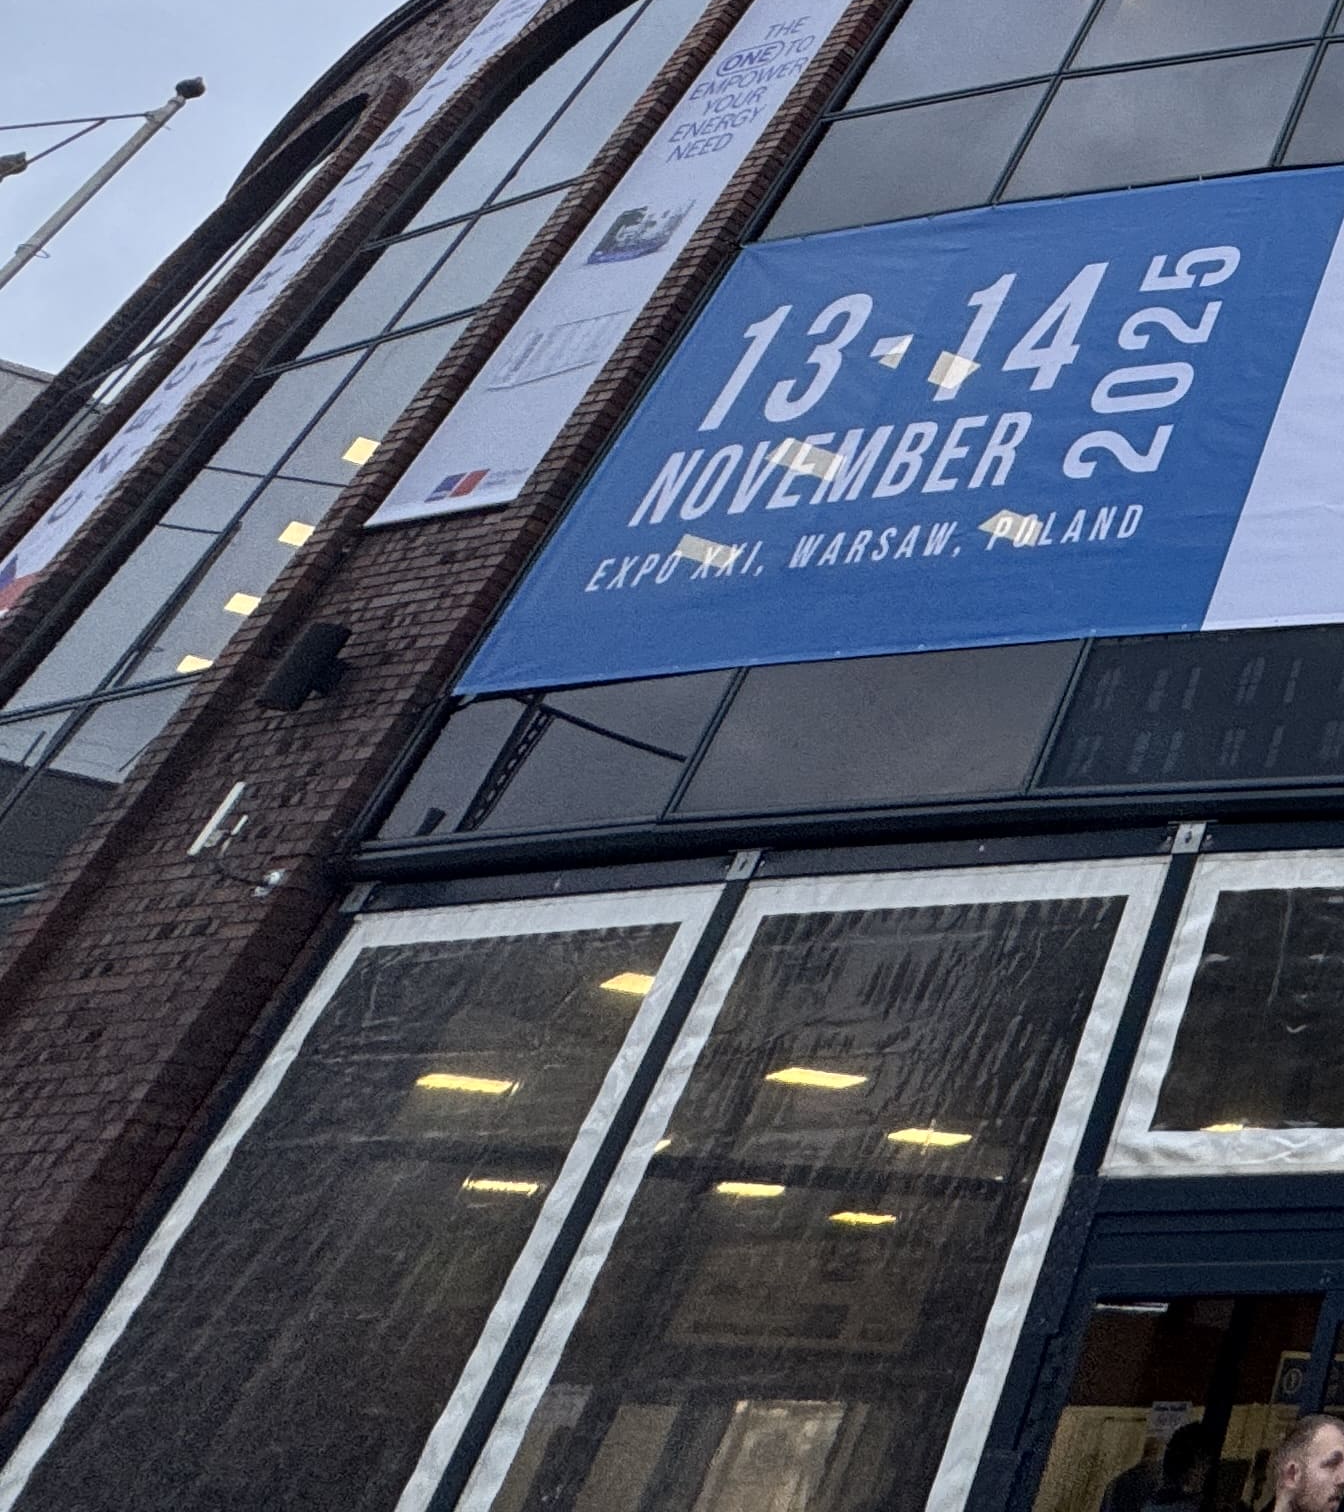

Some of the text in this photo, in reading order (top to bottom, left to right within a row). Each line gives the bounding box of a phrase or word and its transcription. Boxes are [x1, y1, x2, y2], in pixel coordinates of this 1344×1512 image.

[765, 15, 811, 40] THE
[723, 35, 815, 71] ONE TO
[689, 56, 809, 101] EMPOWER
[704, 86, 767, 116] YOUR
[668, 104, 767, 143] ENERGY
[665, 132, 733, 163] NEED
[1063, 245, 1241, 479] 2025
[47, 318, 238, 525] CZECH
[629, 411, 1033, 528] NOVEMBER
[585, 504, 1144, 593] EXPO XXI, WARSAW, POLAND
